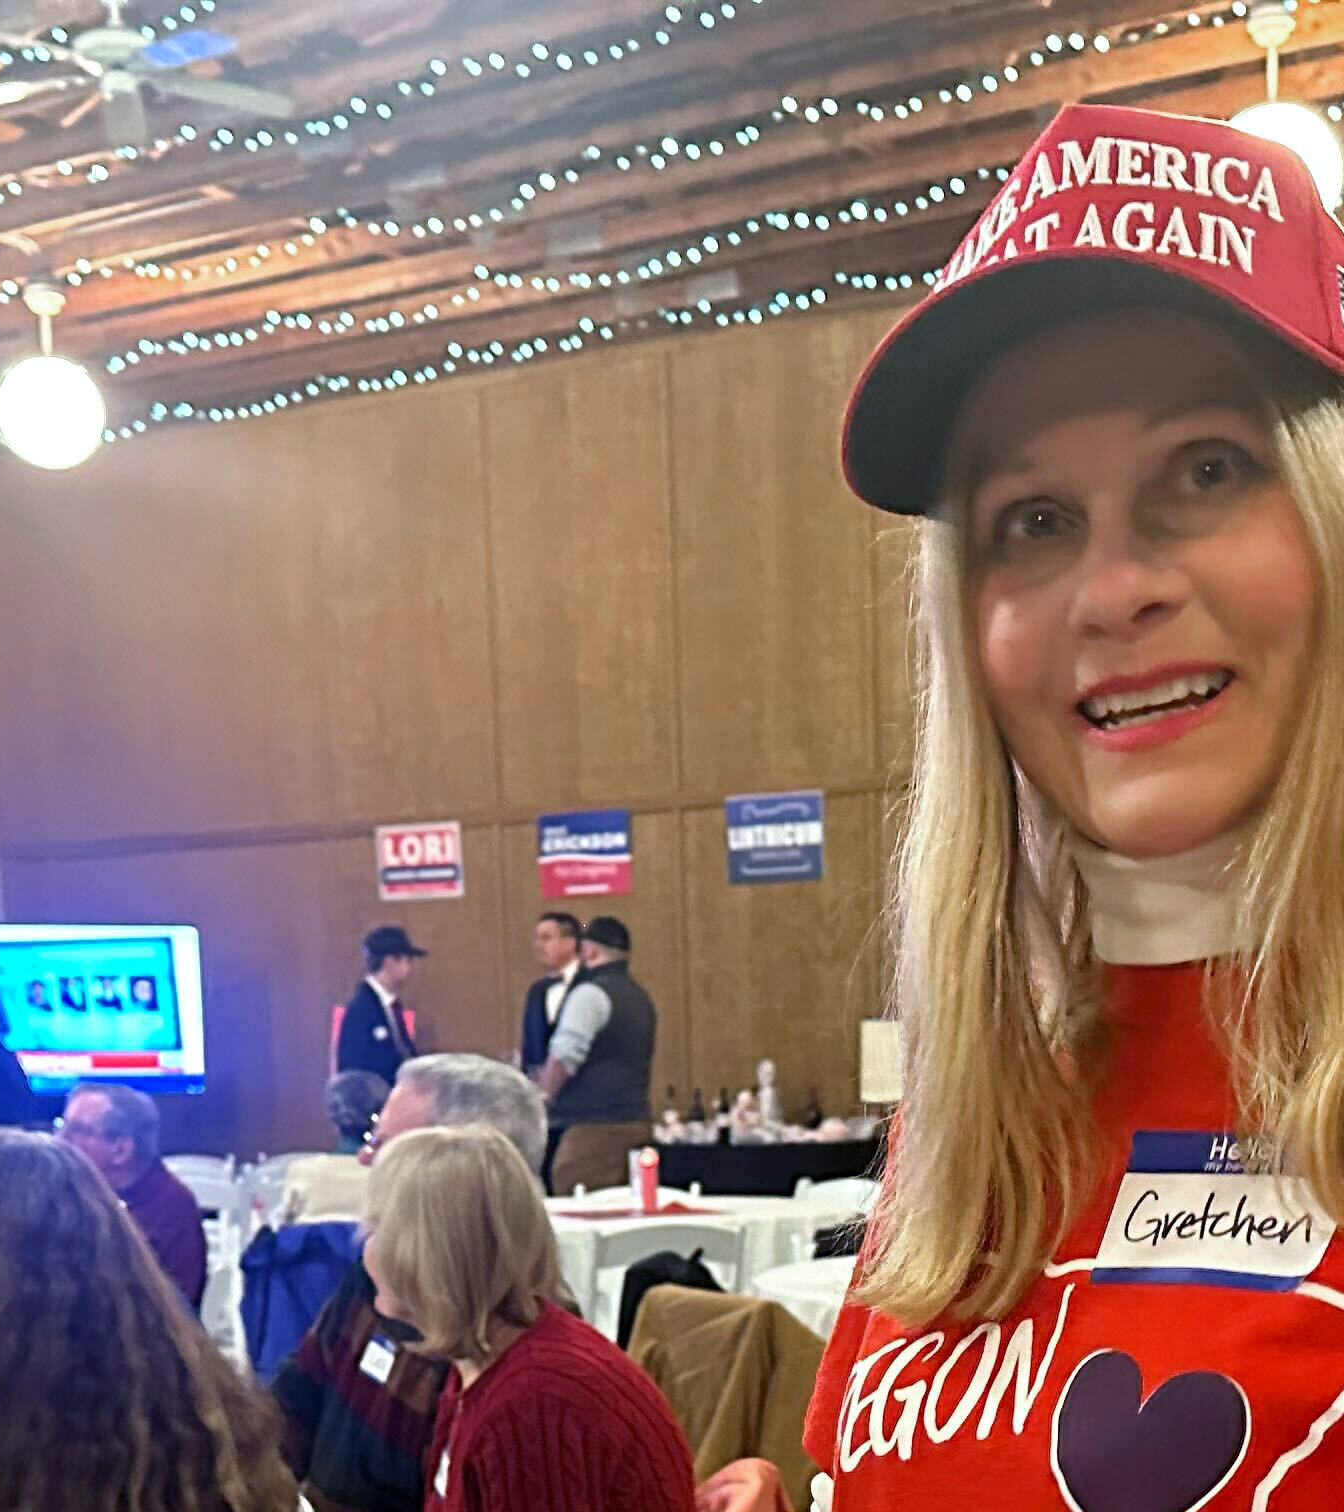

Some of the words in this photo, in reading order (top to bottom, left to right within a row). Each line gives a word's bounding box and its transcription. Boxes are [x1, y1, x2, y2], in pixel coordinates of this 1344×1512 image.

[1020, 136, 1286, 223] AMERICA
[1073, 201, 1256, 275] AGAIN
[384, 833, 454, 865] LORI
[1124, 1190, 1312, 1246] Gretchen
[837, 1283, 1074, 1473] EGON
